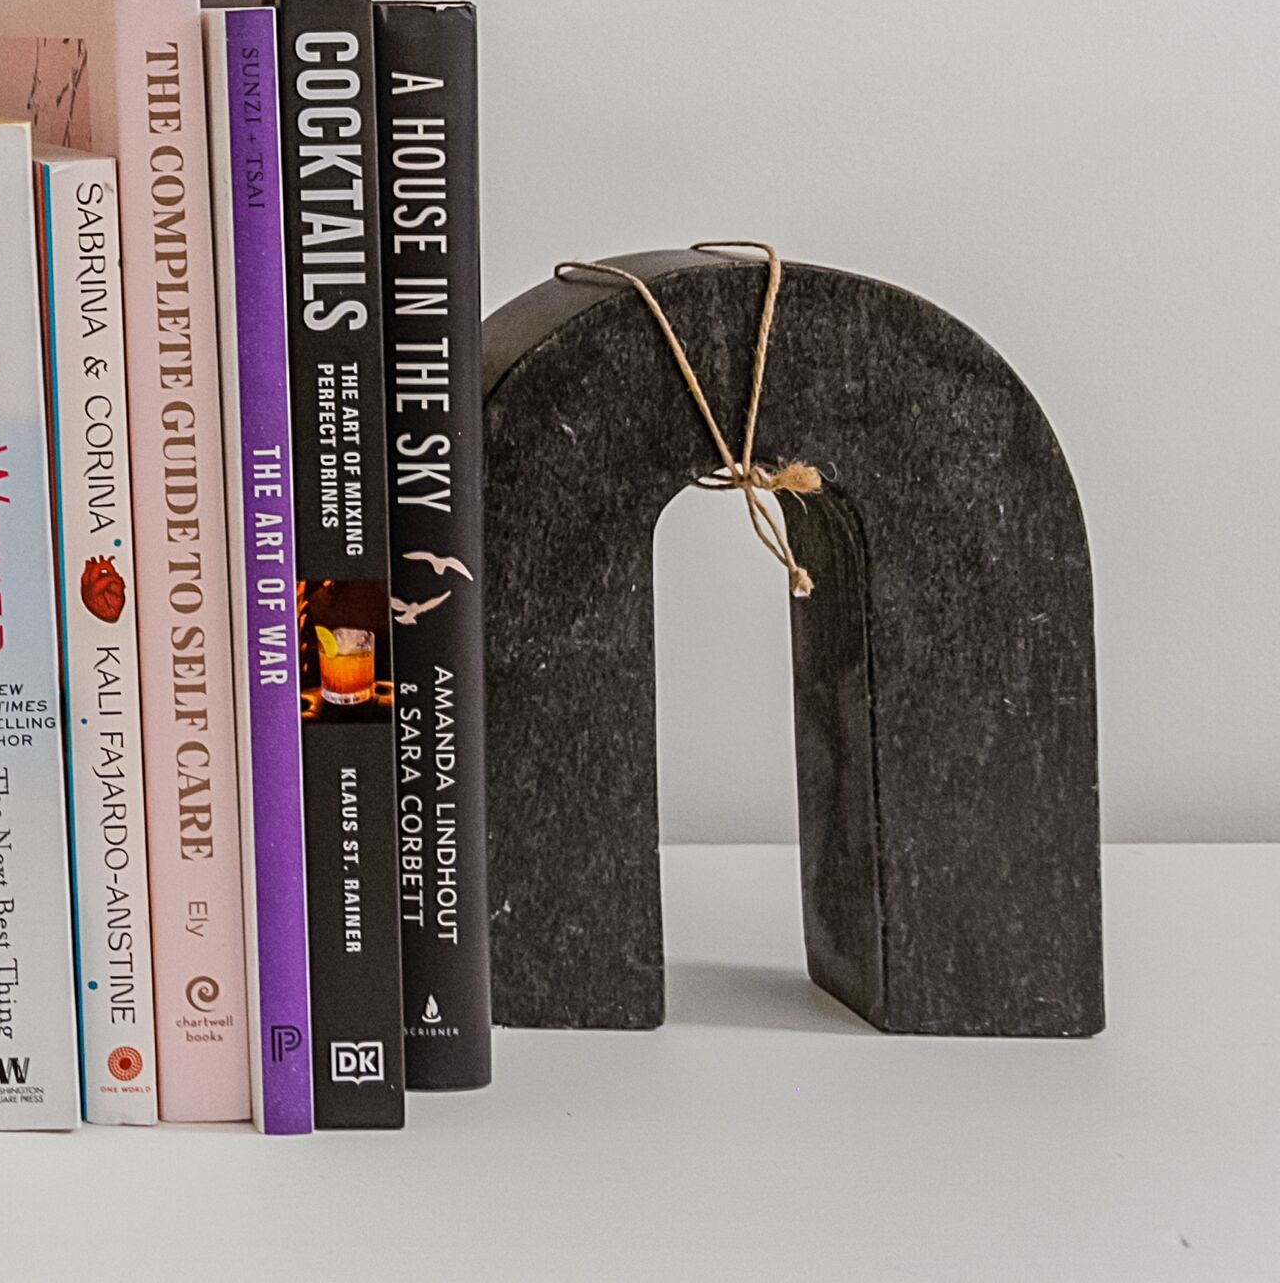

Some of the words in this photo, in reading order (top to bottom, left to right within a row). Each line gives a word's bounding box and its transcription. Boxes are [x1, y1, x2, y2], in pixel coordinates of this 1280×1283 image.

[145, 42, 182, 134] THE
[241, 47, 263, 123] SUNZI
[391, 71, 445, 96] A
[244, 152, 266, 210] TSAI
[295, 31, 369, 332] COCKTAILS
[391, 117, 448, 256] HOUSE
[75, 181, 108, 338] SABRINA
[149, 144, 195, 392] COMPLETE
[394, 277, 449, 317] IN
[82, 355, 108, 380] &
[317, 362, 337, 448] PERFECT
[340, 361, 359, 400] THE
[395, 336, 450, 414] THE
[342, 406, 361, 444] ART
[84, 394, 117, 534] CORINA
[160, 399, 201, 545] GUIDE
[252, 444, 283, 499] THE
[320, 454, 340, 529] DRINKS
[343, 450, 361, 476] OF
[395, 432, 453, 513] SKY
[254, 513, 285, 565] ART
[344, 481, 363, 557] MIXING
[167, 548, 204, 618] TO
[256, 576, 286, 612] OF
[95, 645, 123, 717] KALI
[168, 625, 209, 732] SELF
[258, 625, 288, 687] WAR
[399, 681, 415, 694] &
[399, 706, 422, 785] SARA
[433, 665, 456, 791] AMANDA
[175, 739, 215, 863] CARE
[341, 768, 359, 832] KLAUS
[92, 730, 137, 1025] FAJARDO-ANSTINE
[342, 839, 359, 871] ST.
[400, 793, 425, 927] CORBETT
[435, 802, 458, 946] LINDHOUT
[184, 900, 209, 938] Ely
[344, 878, 362, 954] RAINER
[176, 1015, 234, 1028] chartwell
[186, 1031, 224, 1043] books
[338, 1050, 377, 1073] DK
